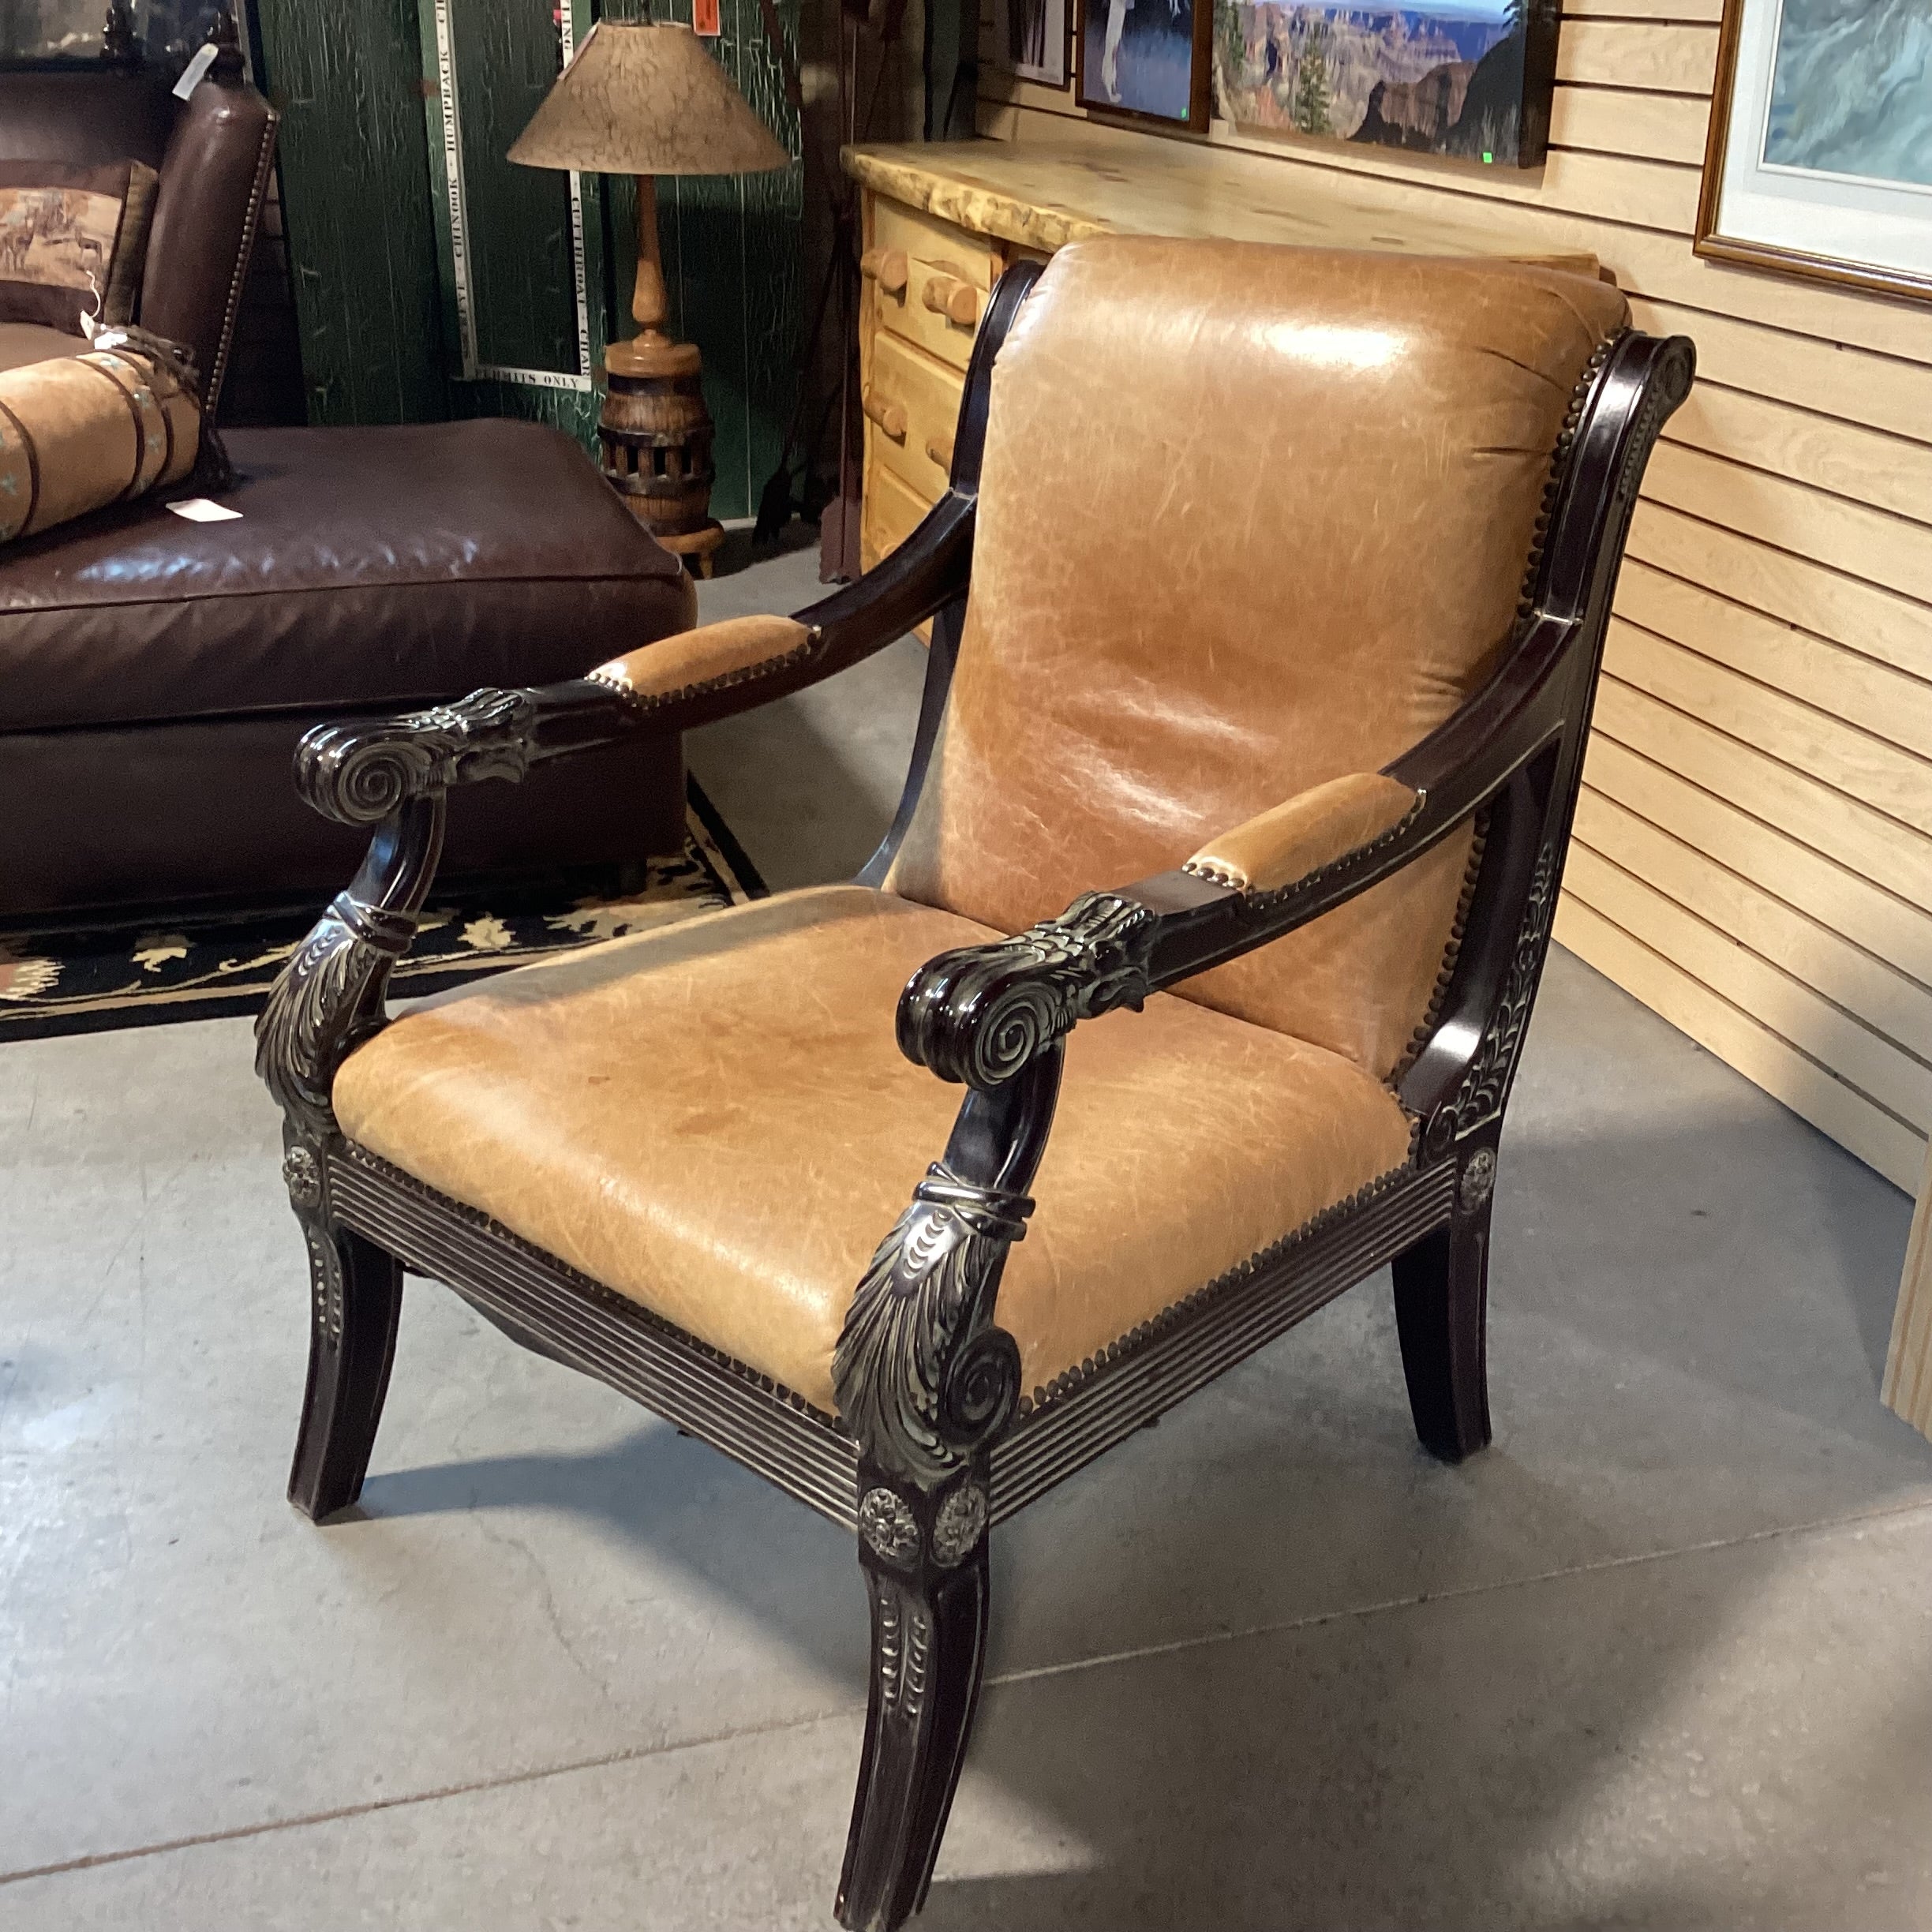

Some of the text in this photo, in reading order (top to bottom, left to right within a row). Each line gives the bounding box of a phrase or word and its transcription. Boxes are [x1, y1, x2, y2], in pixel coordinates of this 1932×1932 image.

[440, 51, 455, 151] HUMPBACK
[449, 178, 462, 258] CHINOOK
[561, 0, 571, 50] LING
[580, 329, 590, 376] CHAR
[544, 375, 579, 388] ONLY
